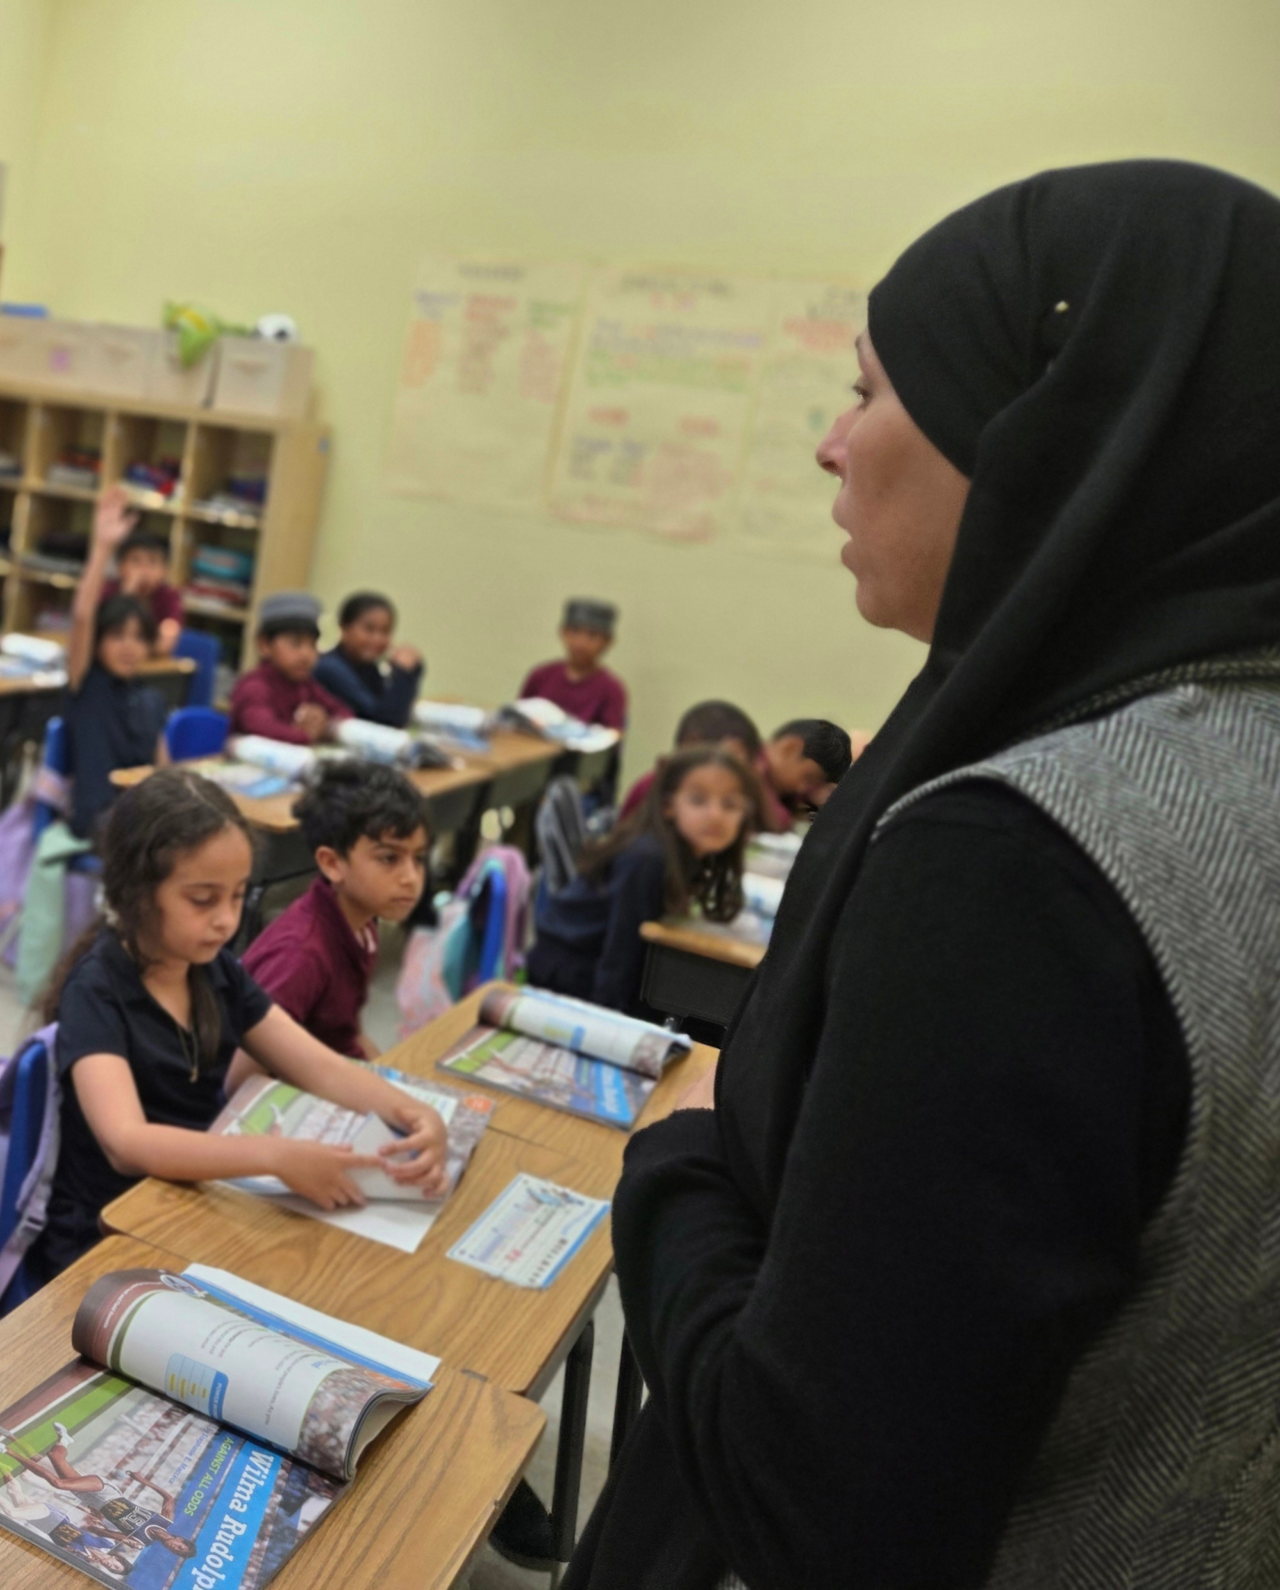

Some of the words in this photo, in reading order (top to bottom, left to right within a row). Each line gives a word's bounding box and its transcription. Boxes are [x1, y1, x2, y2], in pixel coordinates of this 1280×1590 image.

[188, 1432, 209, 1460] Stephanie
[209, 1437, 235, 1475] AGAINST
[198, 1472, 214, 1489] ALL
[229, 1450, 275, 1513] Wilma
[183, 1489, 205, 1517] ODDS
